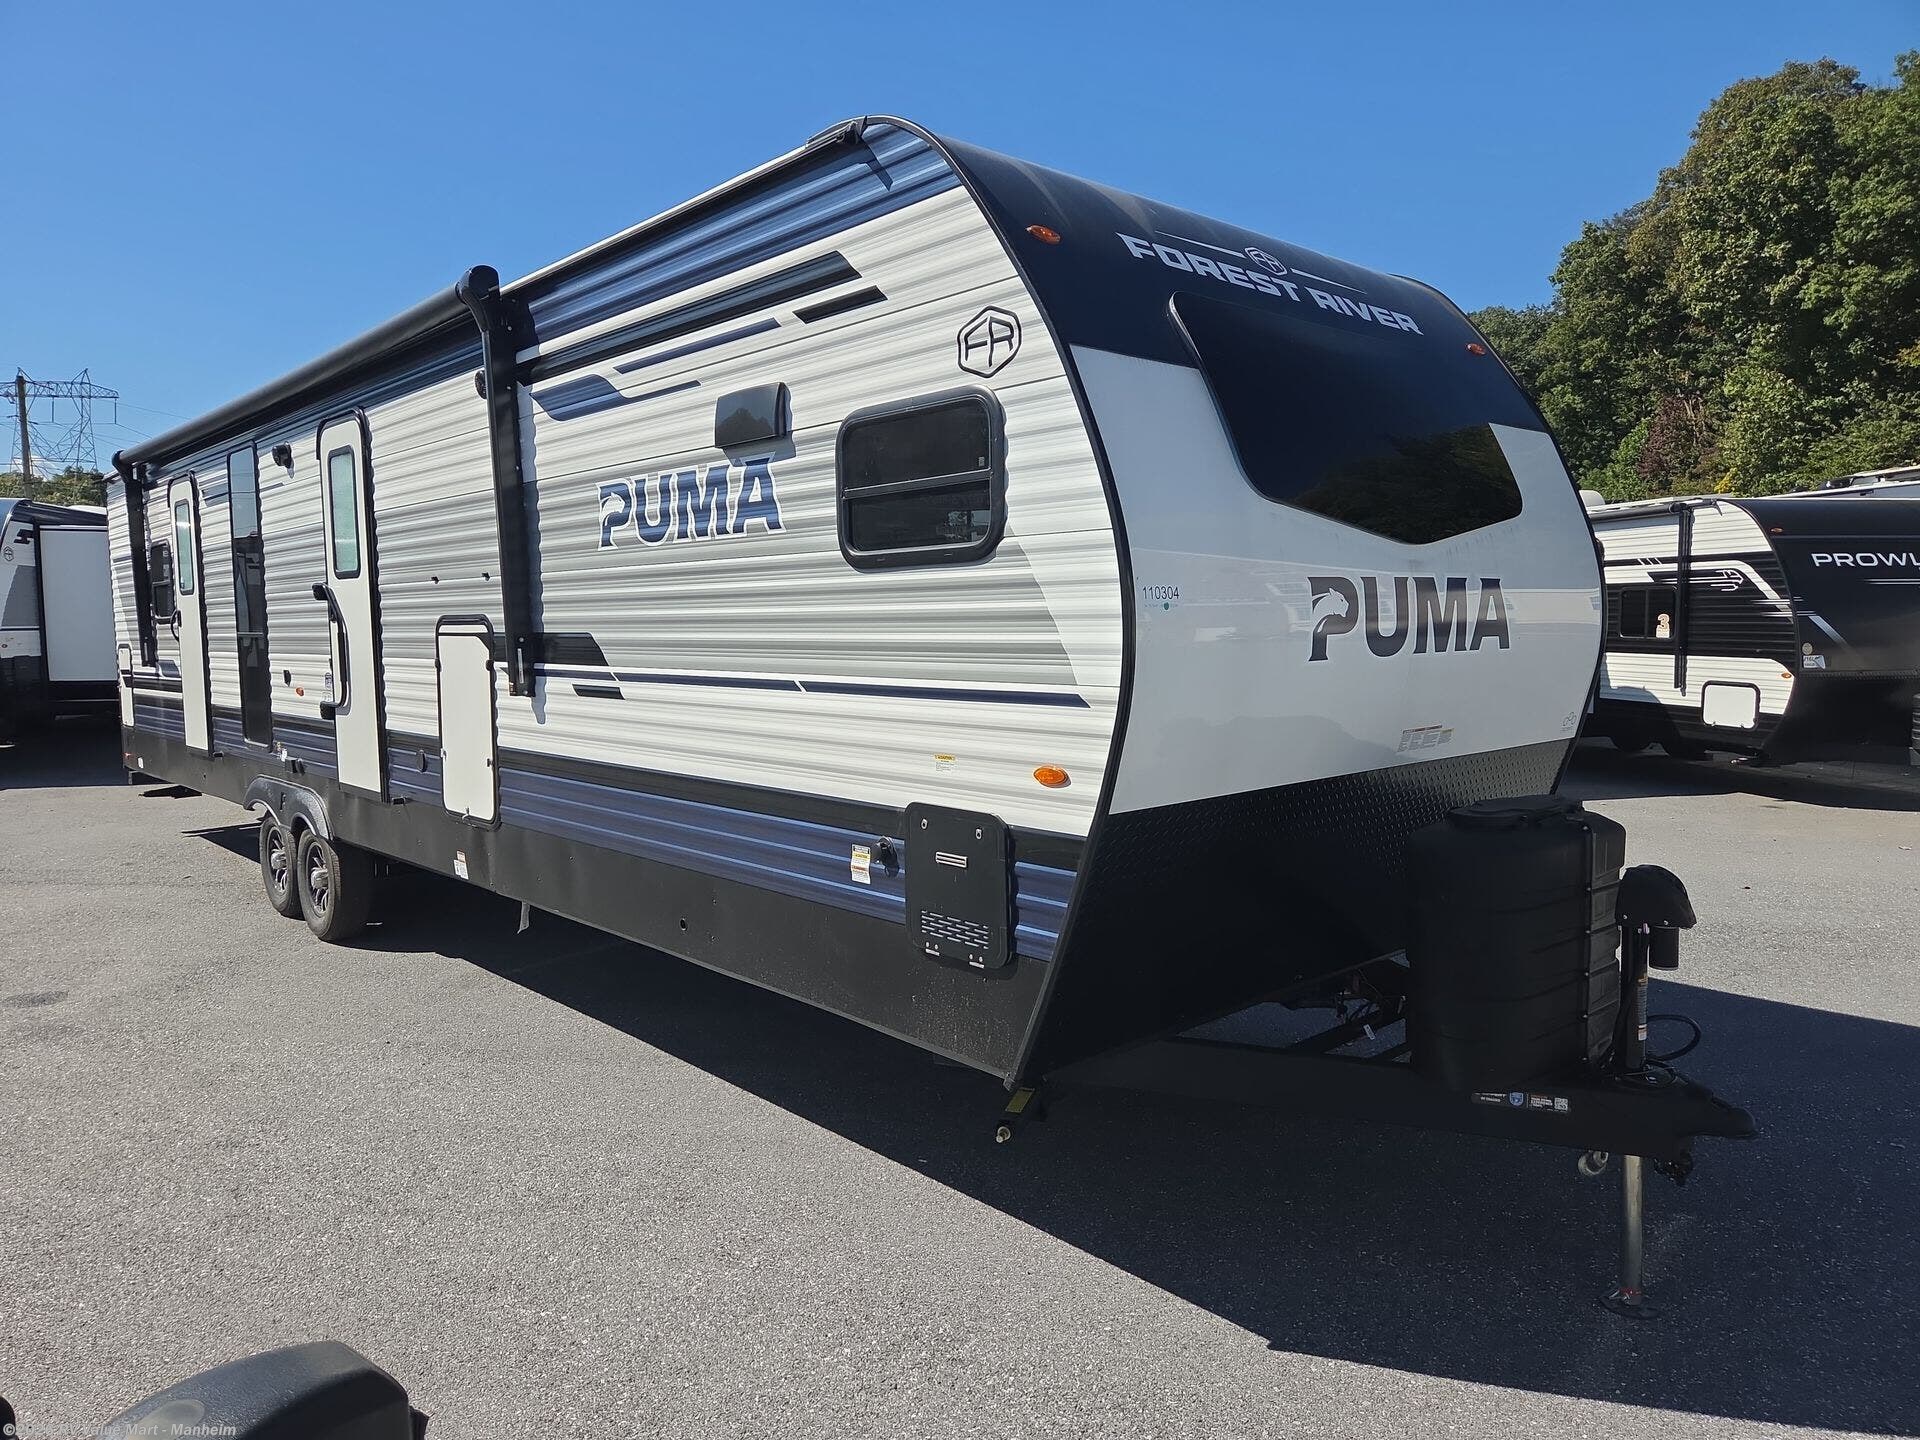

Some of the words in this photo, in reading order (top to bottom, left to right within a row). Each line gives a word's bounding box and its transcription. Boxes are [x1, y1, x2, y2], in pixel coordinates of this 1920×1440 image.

[1115, 231, 1300, 302] FOREST
[1304, 286, 1424, 336] RIVER
[597, 453, 786, 551] PUMA
[1142, 586, 1180, 600] 110304
[1307, 576, 1510, 662] PUMA
